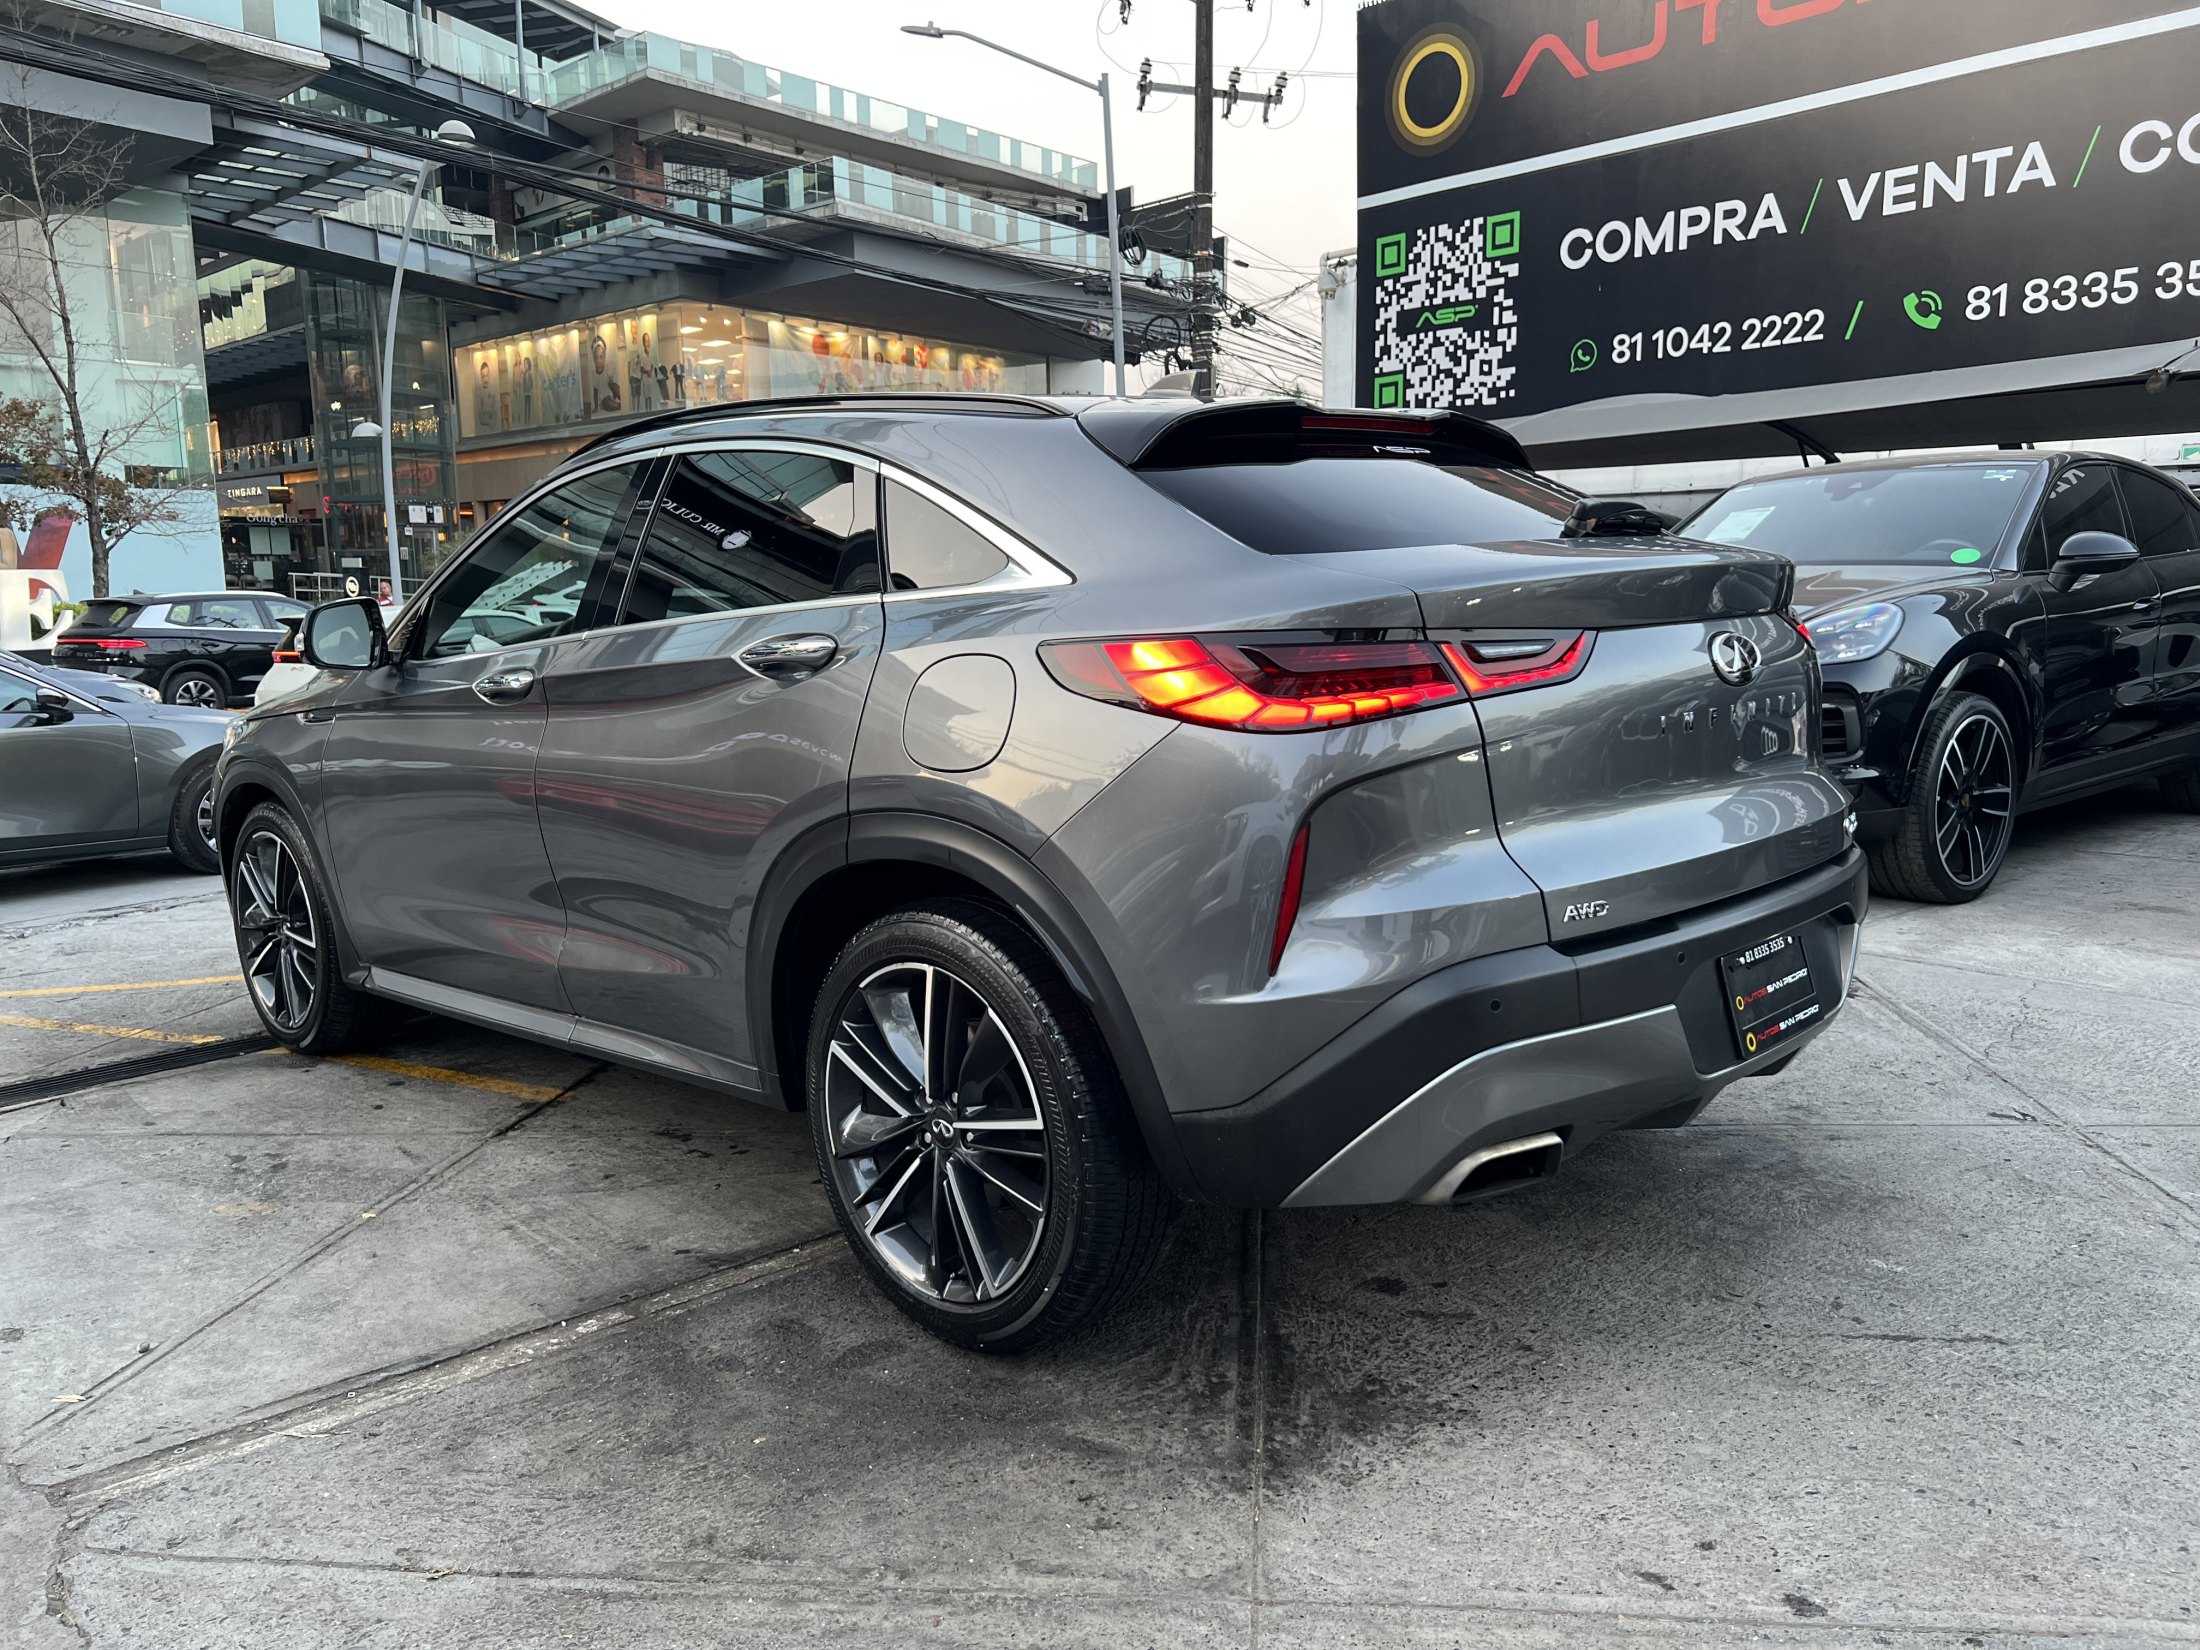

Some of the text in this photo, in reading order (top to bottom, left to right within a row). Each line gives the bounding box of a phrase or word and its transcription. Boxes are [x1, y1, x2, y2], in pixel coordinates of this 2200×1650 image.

[1502, 0, 1870, 98] AUT
[1559, 193, 1787, 270] COMPRA
[1837, 141, 2056, 221] VENTA
[1415, 305, 1476, 328] ASP
[1611, 332, 1643, 364] 81
[1652, 322, 1732, 360] 1042
[1741, 308, 1825, 350] 2222
[1965, 283, 2009, 321] 81
[2022, 266, 2139, 315] 8335
[1563, 900, 1610, 922] AWD
[1769, 937, 1785, 953] 3535
